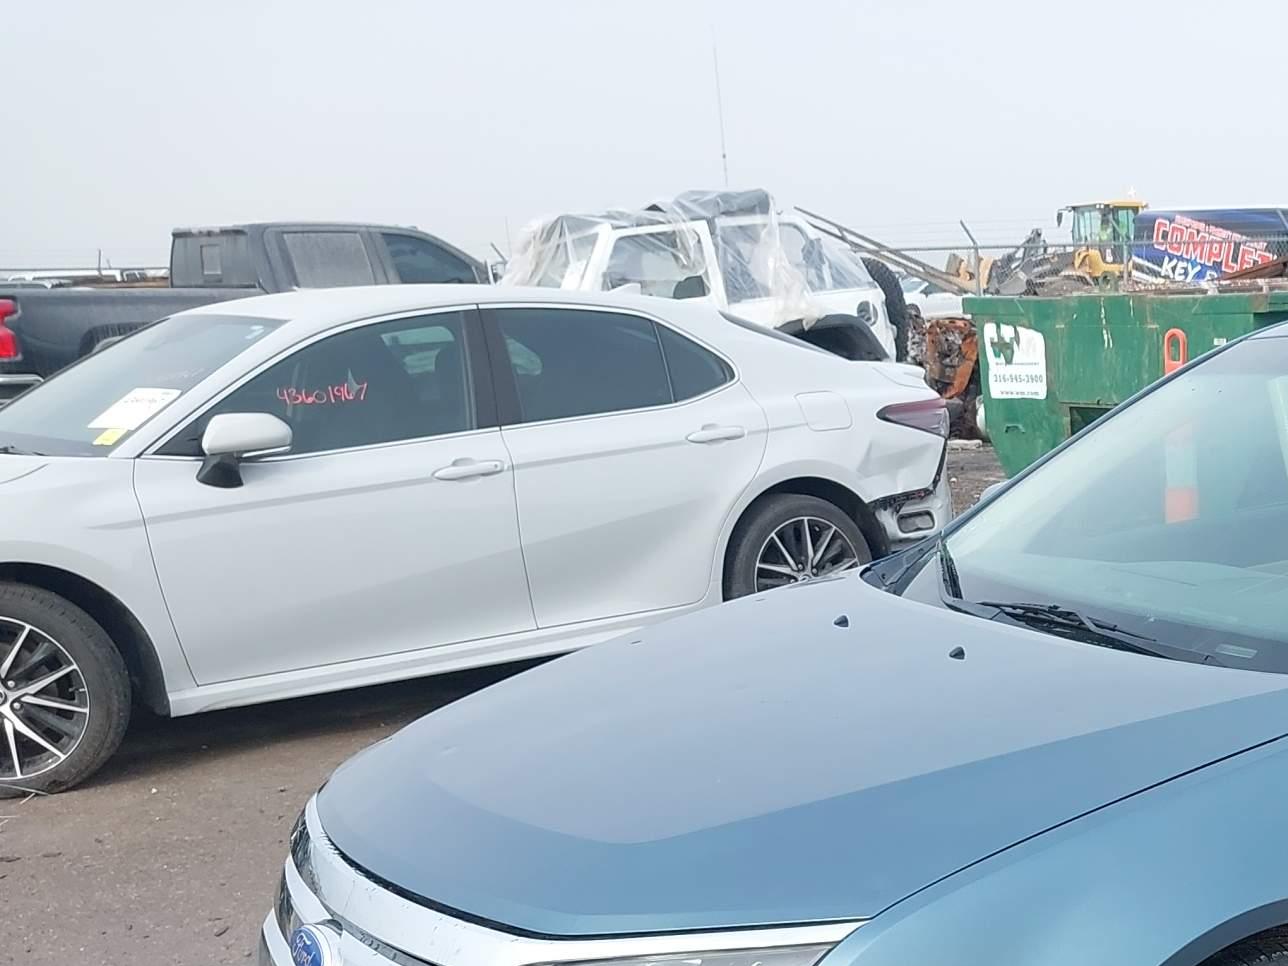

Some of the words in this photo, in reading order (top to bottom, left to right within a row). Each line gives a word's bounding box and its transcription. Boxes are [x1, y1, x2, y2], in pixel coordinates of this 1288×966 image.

[1153, 218, 1279, 275] COMPLET
[1161, 255, 1202, 283] KEY
[276, 382, 368, 405] 43601967
